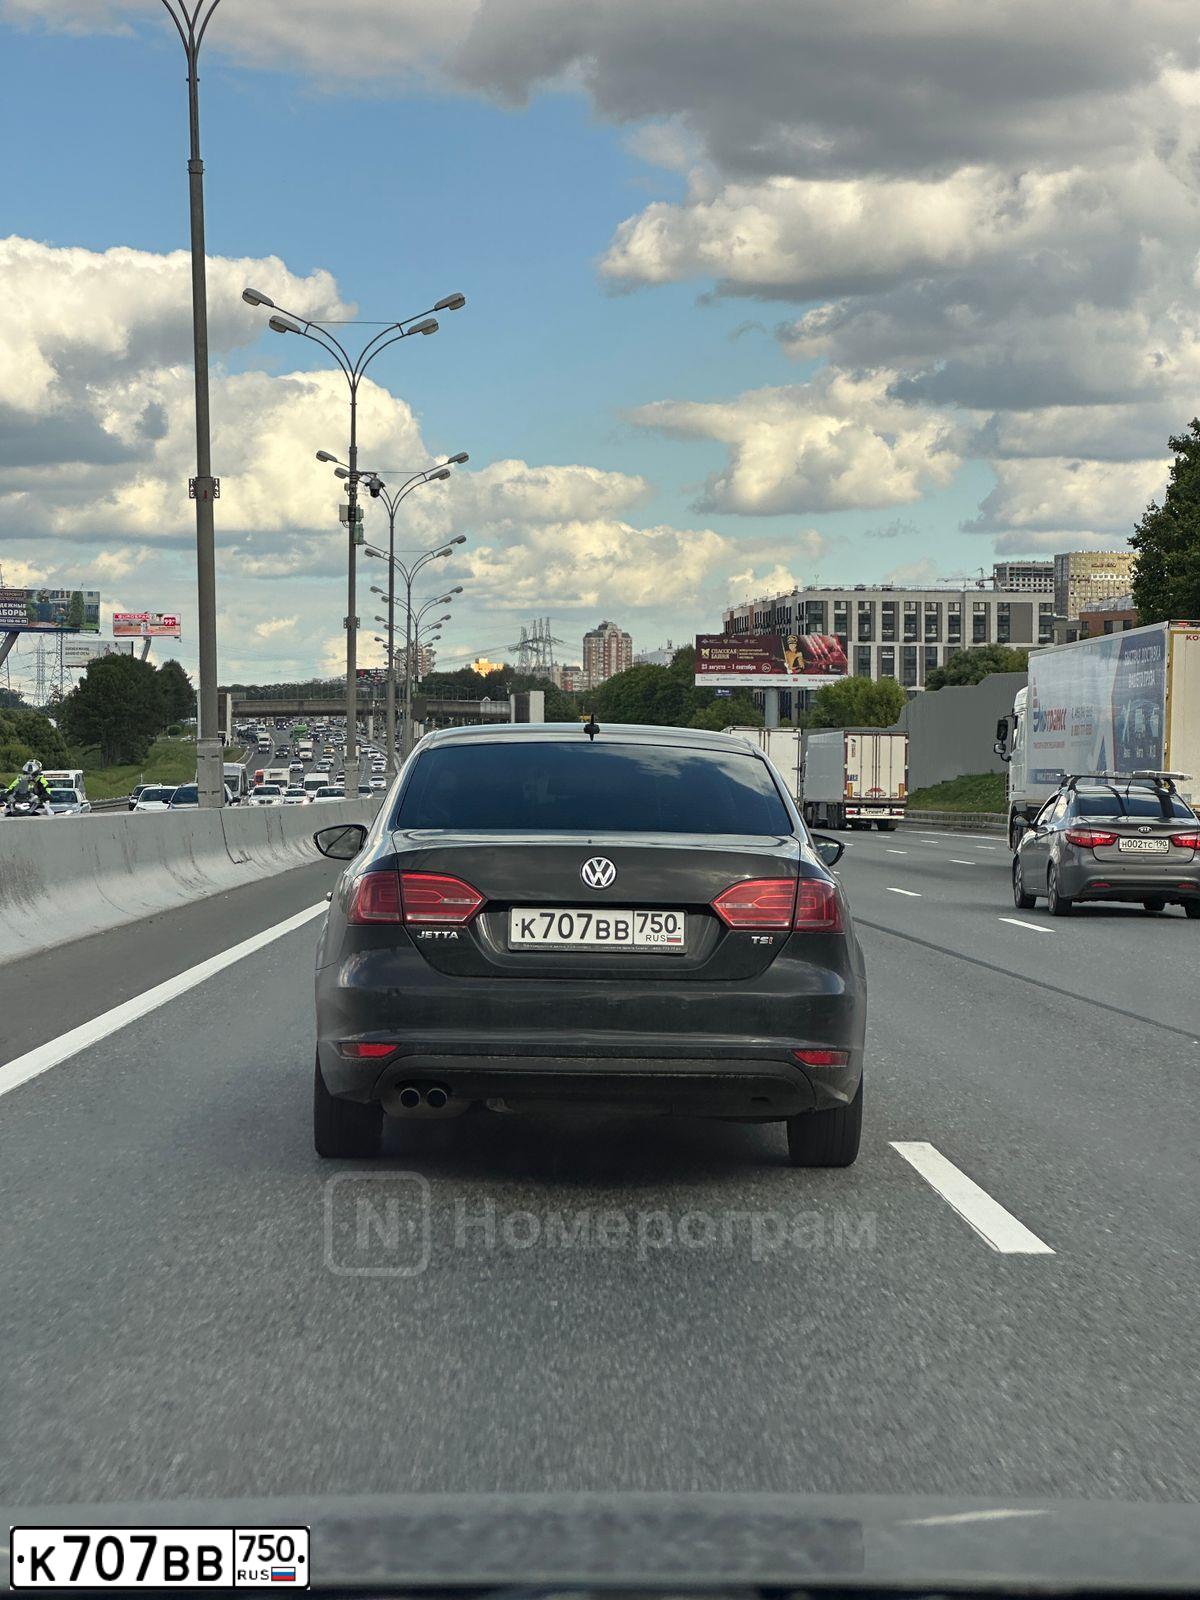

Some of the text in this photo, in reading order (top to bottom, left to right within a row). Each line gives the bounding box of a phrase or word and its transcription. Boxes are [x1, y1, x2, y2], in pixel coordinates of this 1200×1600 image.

[636, 913, 677, 933] 750
[417, 931, 458, 939] JETTA
[645, 934, 666, 942] RUS
